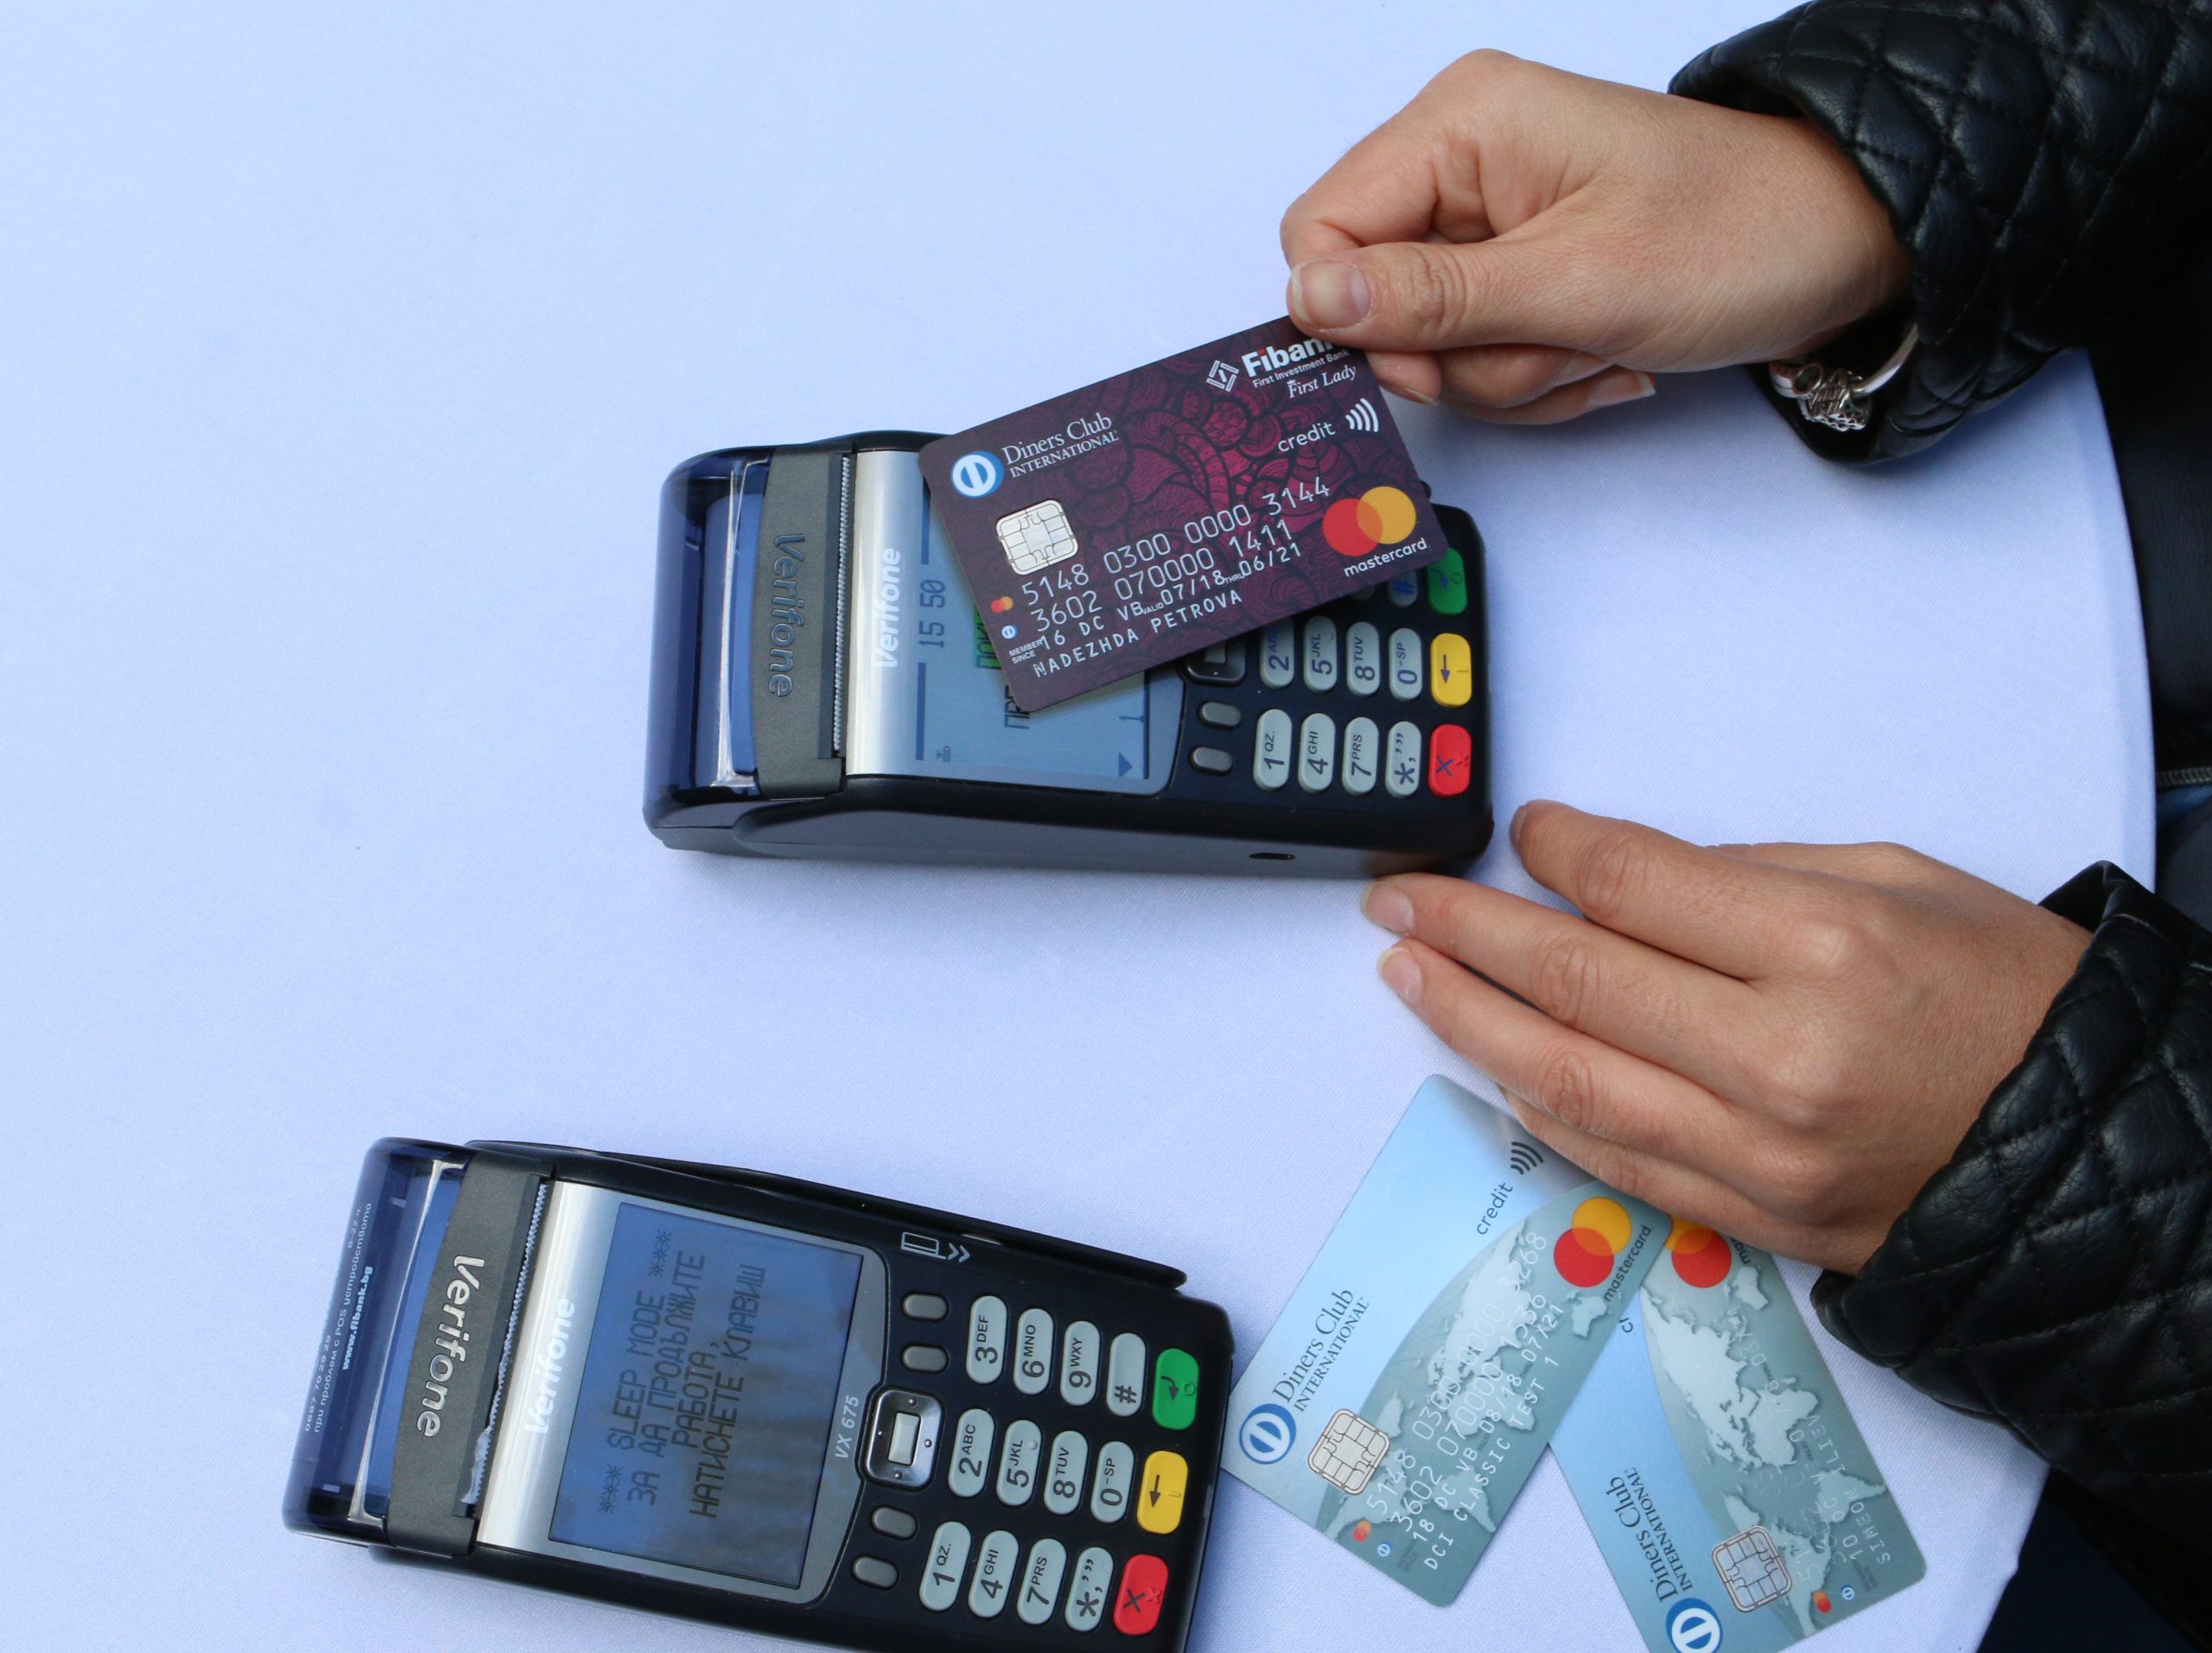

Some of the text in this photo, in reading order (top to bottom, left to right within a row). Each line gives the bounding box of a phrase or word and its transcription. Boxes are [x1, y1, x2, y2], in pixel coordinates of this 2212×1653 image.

[1242, 338, 1331, 378] Fiban
[1253, 348, 1349, 387] First Investment Bank
[1287, 363, 1357, 397] First Lady
[1001, 412, 1114, 467] Diners Club
[1009, 430, 1118, 479] INTERNATIONAL
[1278, 420, 1336, 453] credit
[1022, 476, 1331, 604] 5148 0300 0000 3144
[1033, 519, 1290, 631] 3602 070000 1411
[1344, 537, 1427, 577] mastercard
[769, 533, 806, 697] Verifone
[874, 546, 901, 669] Verifone
[919, 579, 945, 649] 15 50
[1009, 639, 1042, 657] MEMBER
[1033, 629, 1139, 677] NADEZHDA
[1151, 590, 1243, 633] PETROVA
[1039, 630, 1065, 650] 16
[1079, 615, 1104, 635] DC
[1118, 601, 1143, 621] VB
[1141, 600, 1164, 614] VALID
[1161, 569, 1224, 605] 07/18
[1240, 542, 1300, 575] 06/21
[1012, 649, 1035, 664] SINCE
[1472, 1180, 1514, 1235] credit
[1604, 1226, 1652, 1301] mastercard
[335, 1310, 346, 1337] POS
[342, 1266, 373, 1370] www.fibank.bg
[416, 1255, 485, 1438] Verifone
[524, 1296, 574, 1435] Verifone
[607, 1290, 664, 1450] SLEEP MODE
[1273, 1285, 1353, 1401] Diners Club
[1295, 1300, 1367, 1409] INTERNATIONAL
[690, 1263, 766, 1518] НАТИСНЕТЕ КЛАВИШ
[1367, 1448, 1417, 1512] 5148
[1412, 1376, 1461, 1439] 0300
[1500, 1231, 1548, 1292] 3268
[1391, 1288, 1547, 1530] 3602 070000 1536
[639, 1423, 671, 1458] ДА
[835, 1394, 860, 1459] VX 675
[1411, 1517, 1436, 1544] 18
[1433, 1481, 1458, 1508] DC
[1454, 1446, 1479, 1472] VB
[1478, 1373, 1522, 1433] 08/18
[1521, 1304, 1564, 1360] 07/21
[1423, 1354, 1560, 1568] DCI CLASSIC TEST 1
[627, 1471, 660, 1506] ЗА
[1603, 1475, 1677, 1599] Diners Club
[1626, 1467, 1691, 1590] INTERNATIONAL
